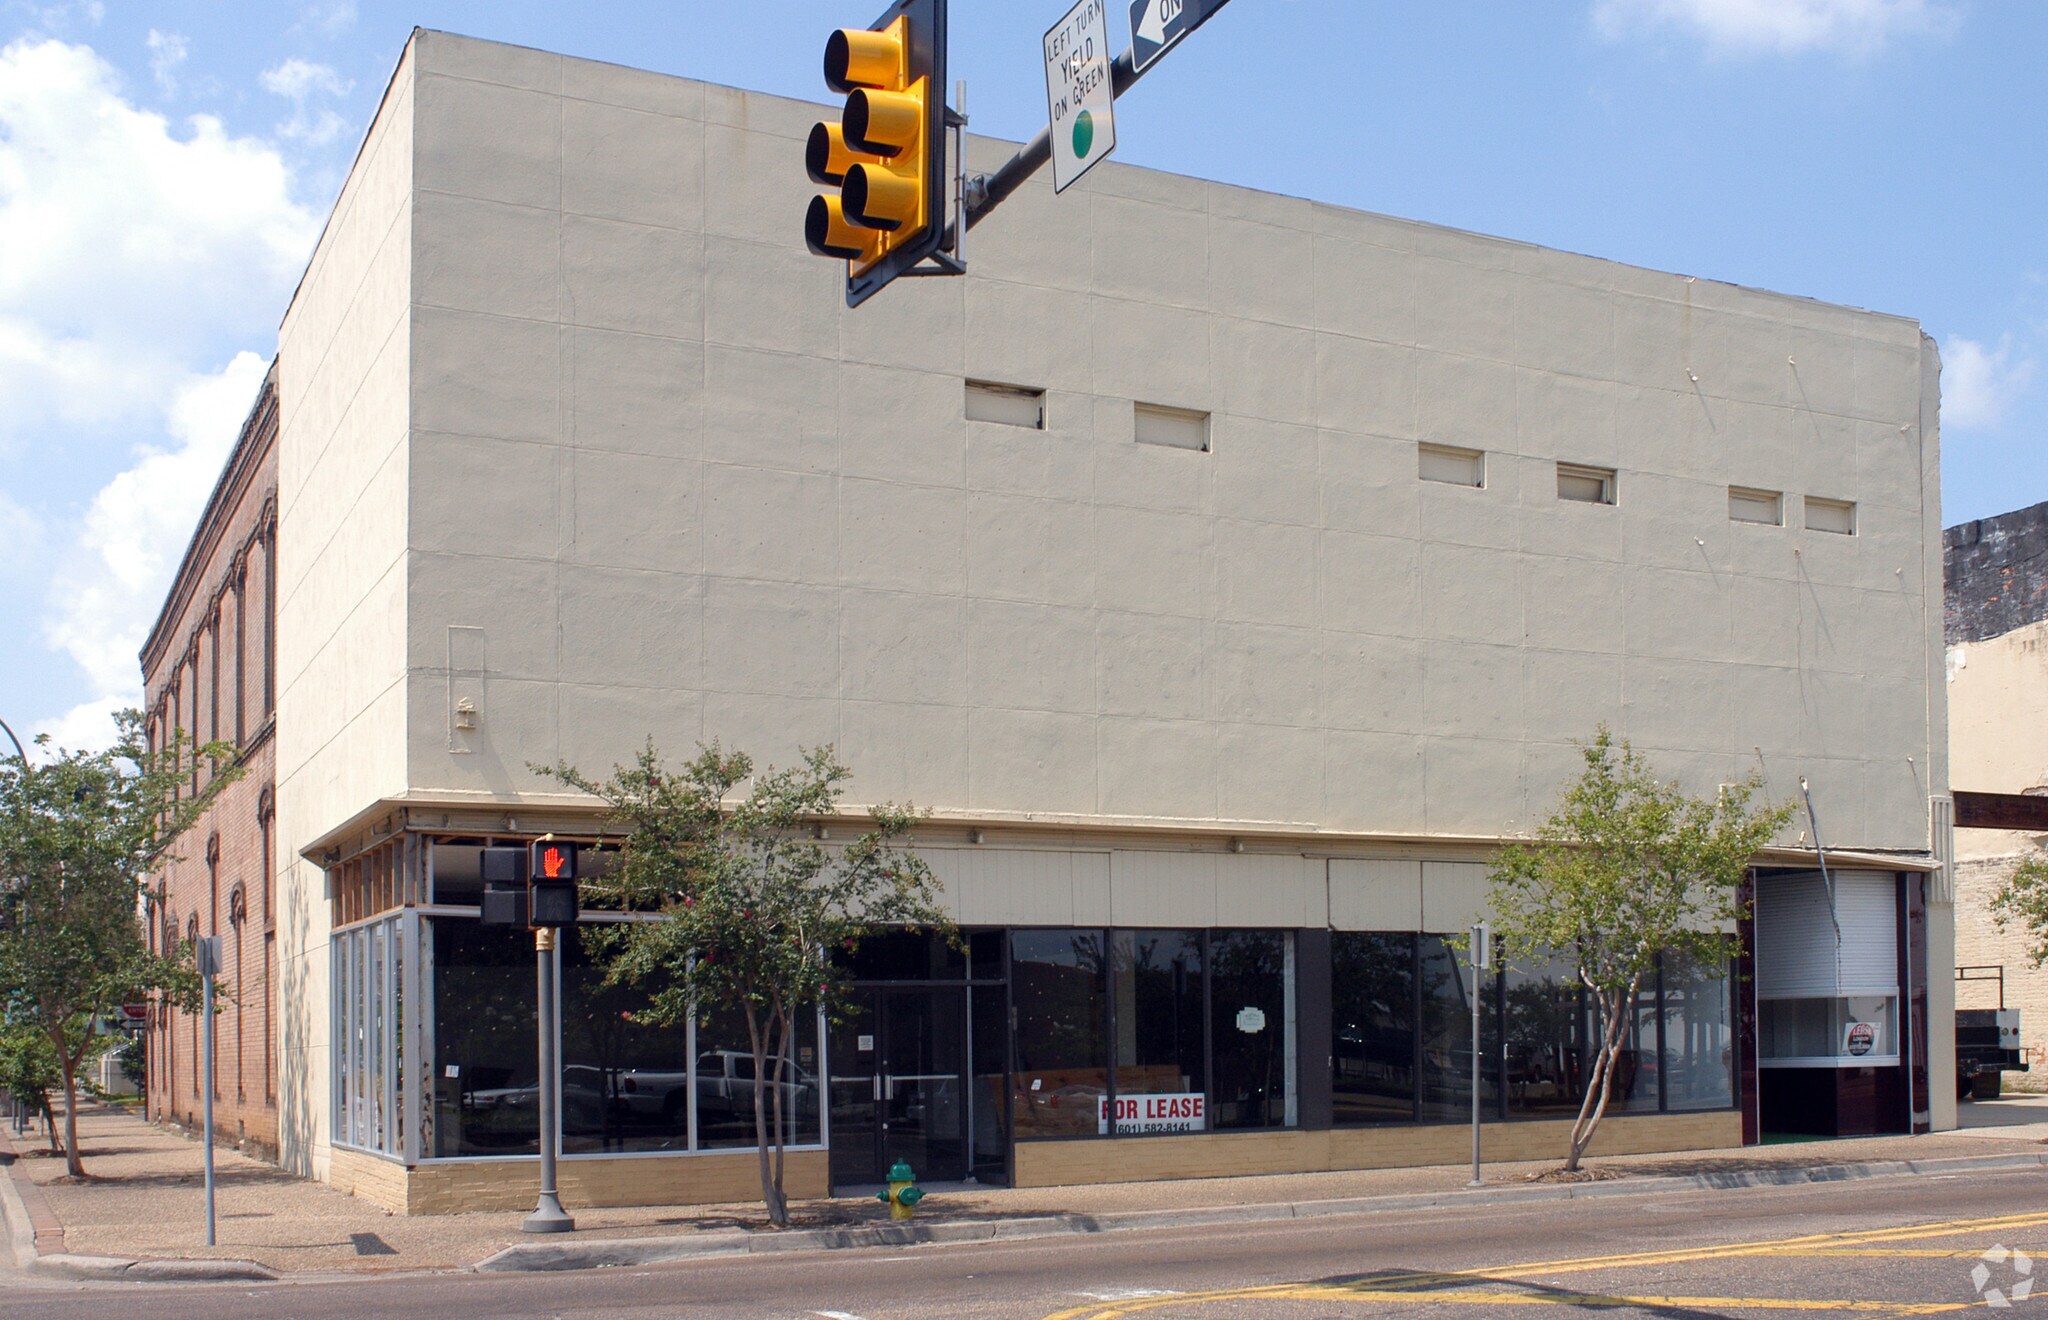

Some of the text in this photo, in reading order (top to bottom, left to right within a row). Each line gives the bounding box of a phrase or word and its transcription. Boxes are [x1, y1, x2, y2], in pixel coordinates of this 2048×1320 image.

[1047, 0, 1100, 62] LEFT TURN
[1061, 37, 1094, 84] YIELD
[1055, 62, 1104, 121] ON GREEN
[1102, 1098, 1202, 1119] FOR LEASE
[1144, 1123, 1190, 1133] 582-8141
